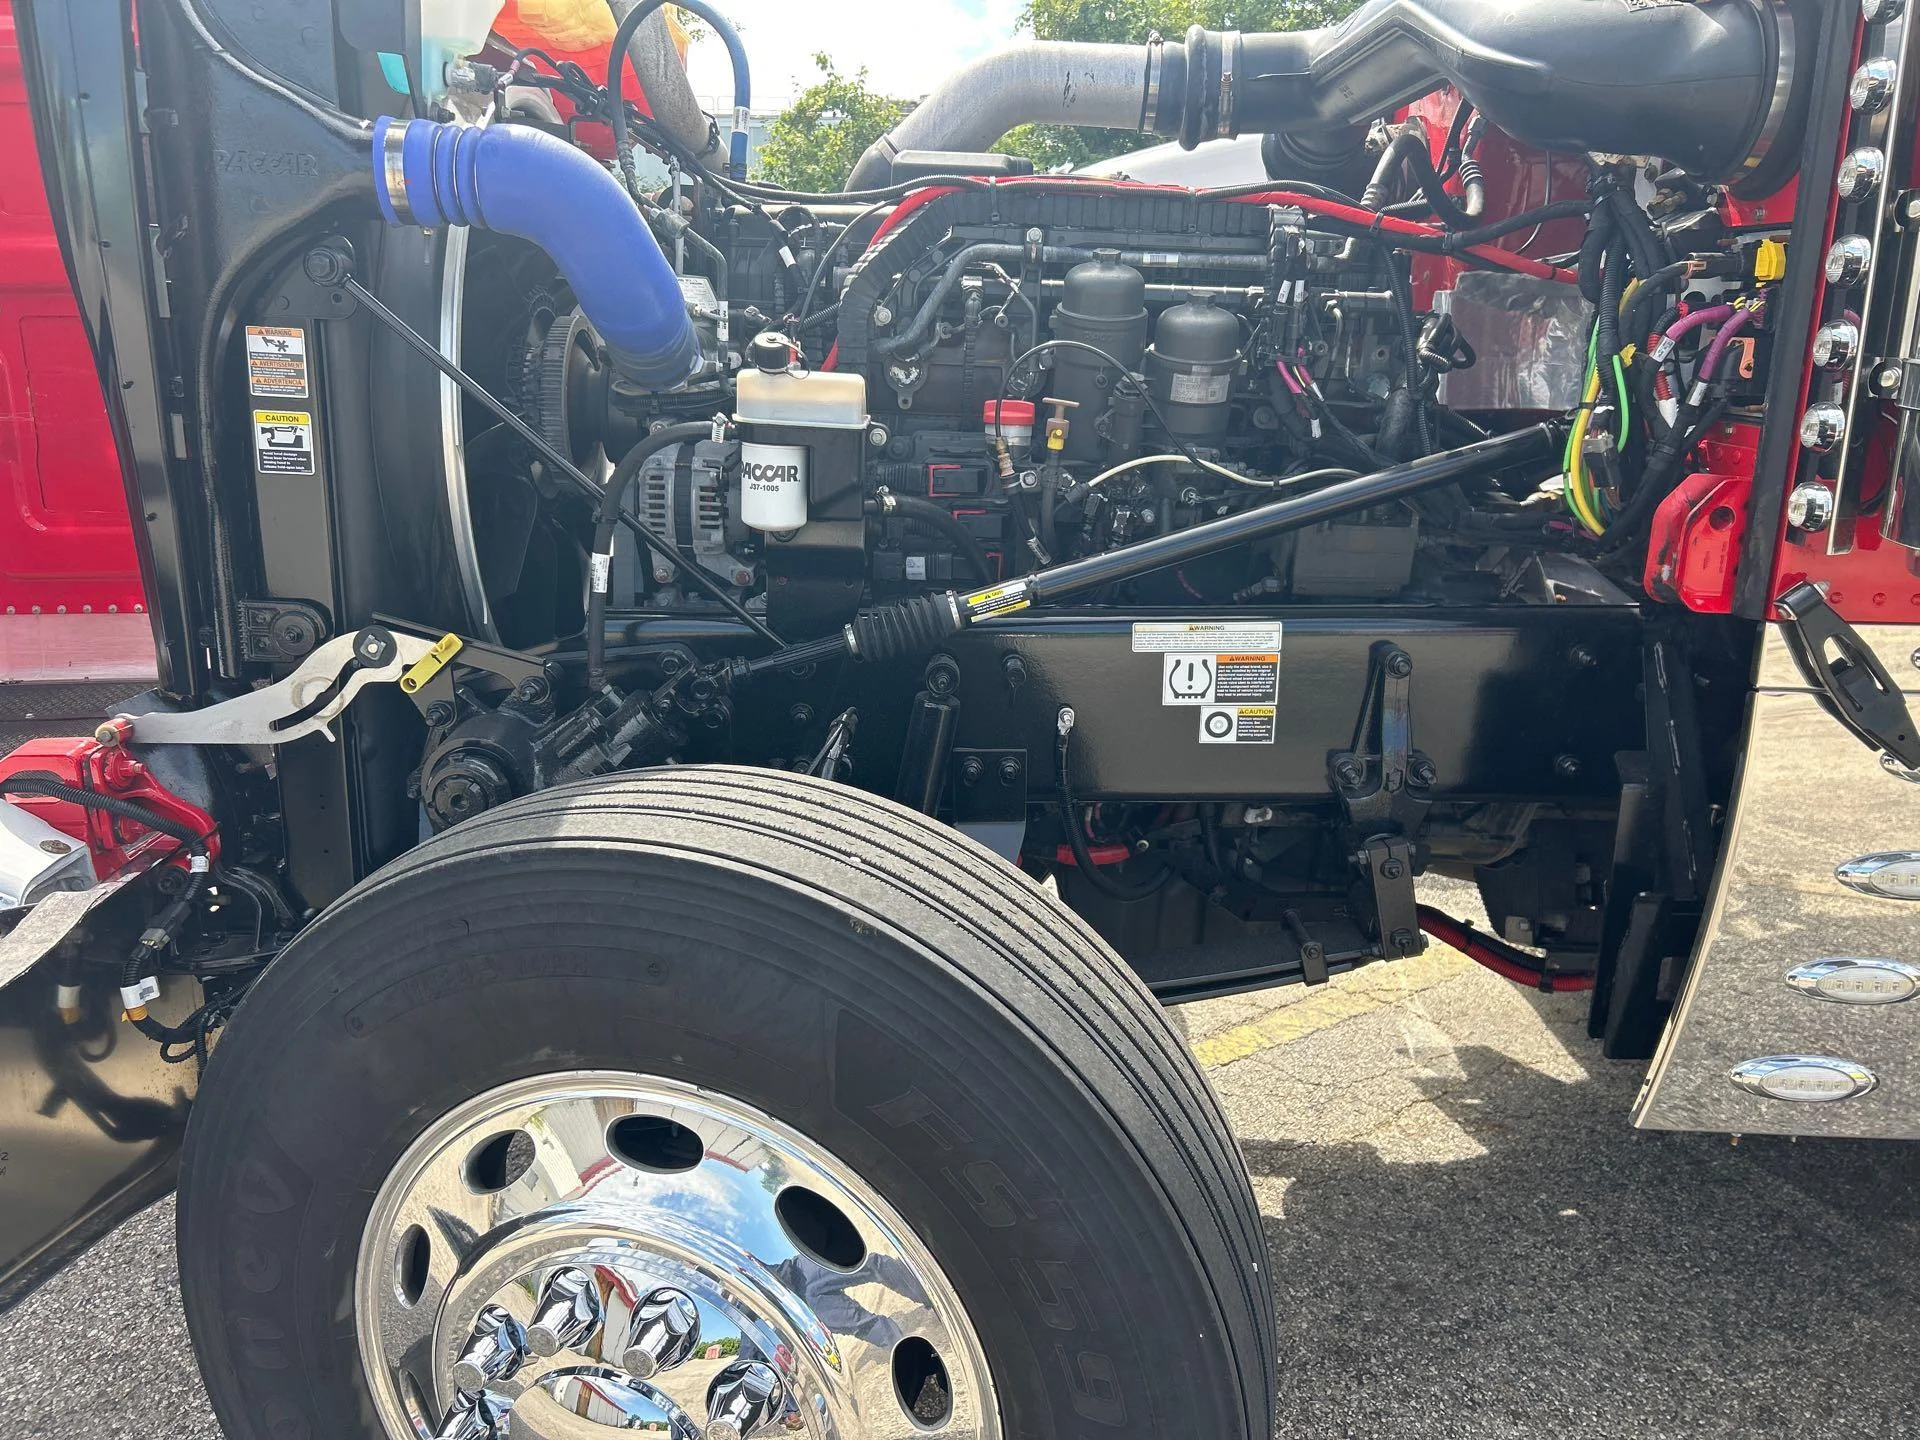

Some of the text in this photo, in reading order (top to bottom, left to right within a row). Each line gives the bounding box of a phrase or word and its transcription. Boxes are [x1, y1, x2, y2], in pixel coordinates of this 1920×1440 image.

[259, 360, 303, 368] AVERTISSEMENT
[264, 378, 303, 386] ADVERTENCIA
[265, 414, 300, 423] CAUTION
[749, 483, 780, 492] J37-1005
[865, 1085, 1128, 1440] FS59
